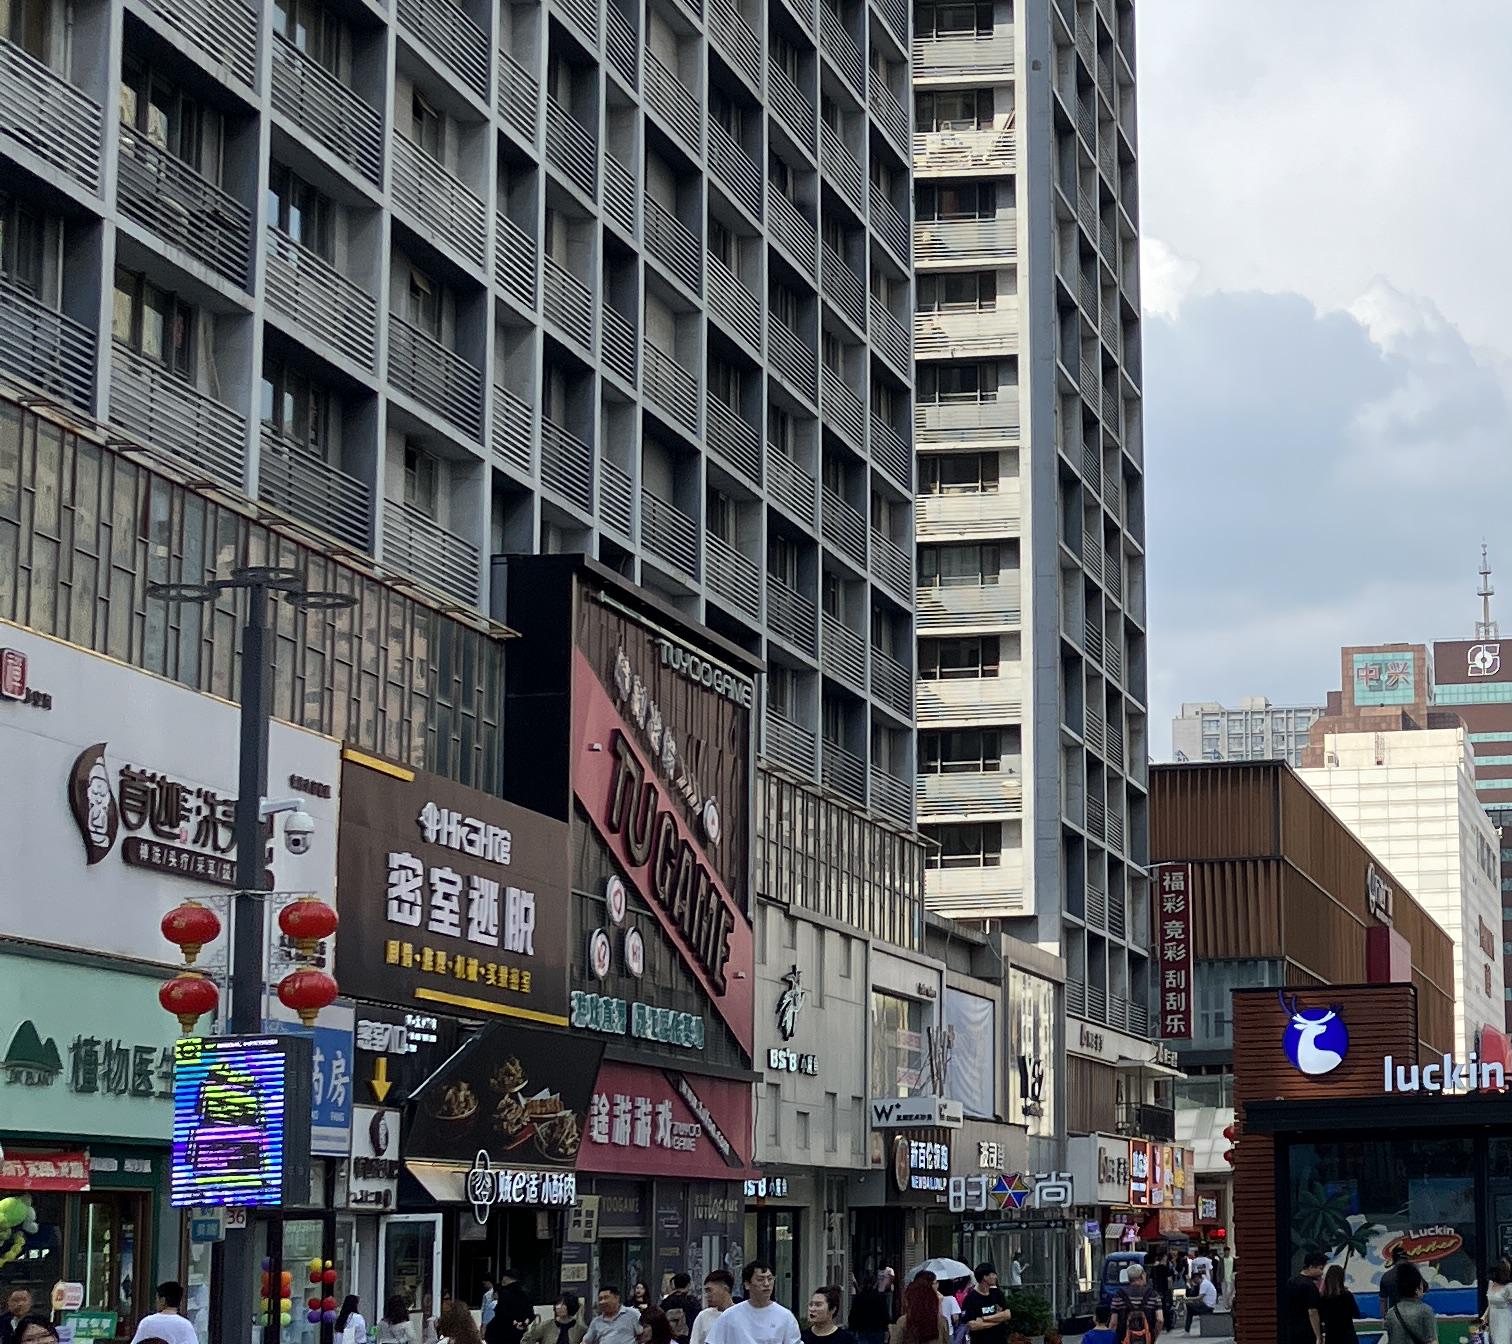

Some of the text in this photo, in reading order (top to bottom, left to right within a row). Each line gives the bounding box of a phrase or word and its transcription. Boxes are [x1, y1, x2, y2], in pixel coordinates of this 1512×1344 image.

[1357, 662, 1410, 688] 中兴
[387, 852, 537, 956] 密室逃脱
[1162, 871, 1185, 914] 福彩
[1163, 920, 1186, 962] 竞彩
[1165, 969, 1186, 1034] 刮刮乐
[66, 1034, 176, 1098] 植物医生
[1384, 1053, 1504, 1091] luckin
[950, 1171, 1073, 1212] 时 尚
[227, 1209, 245, 1224] 36
[1409, 1225, 1455, 1238] Luckin
